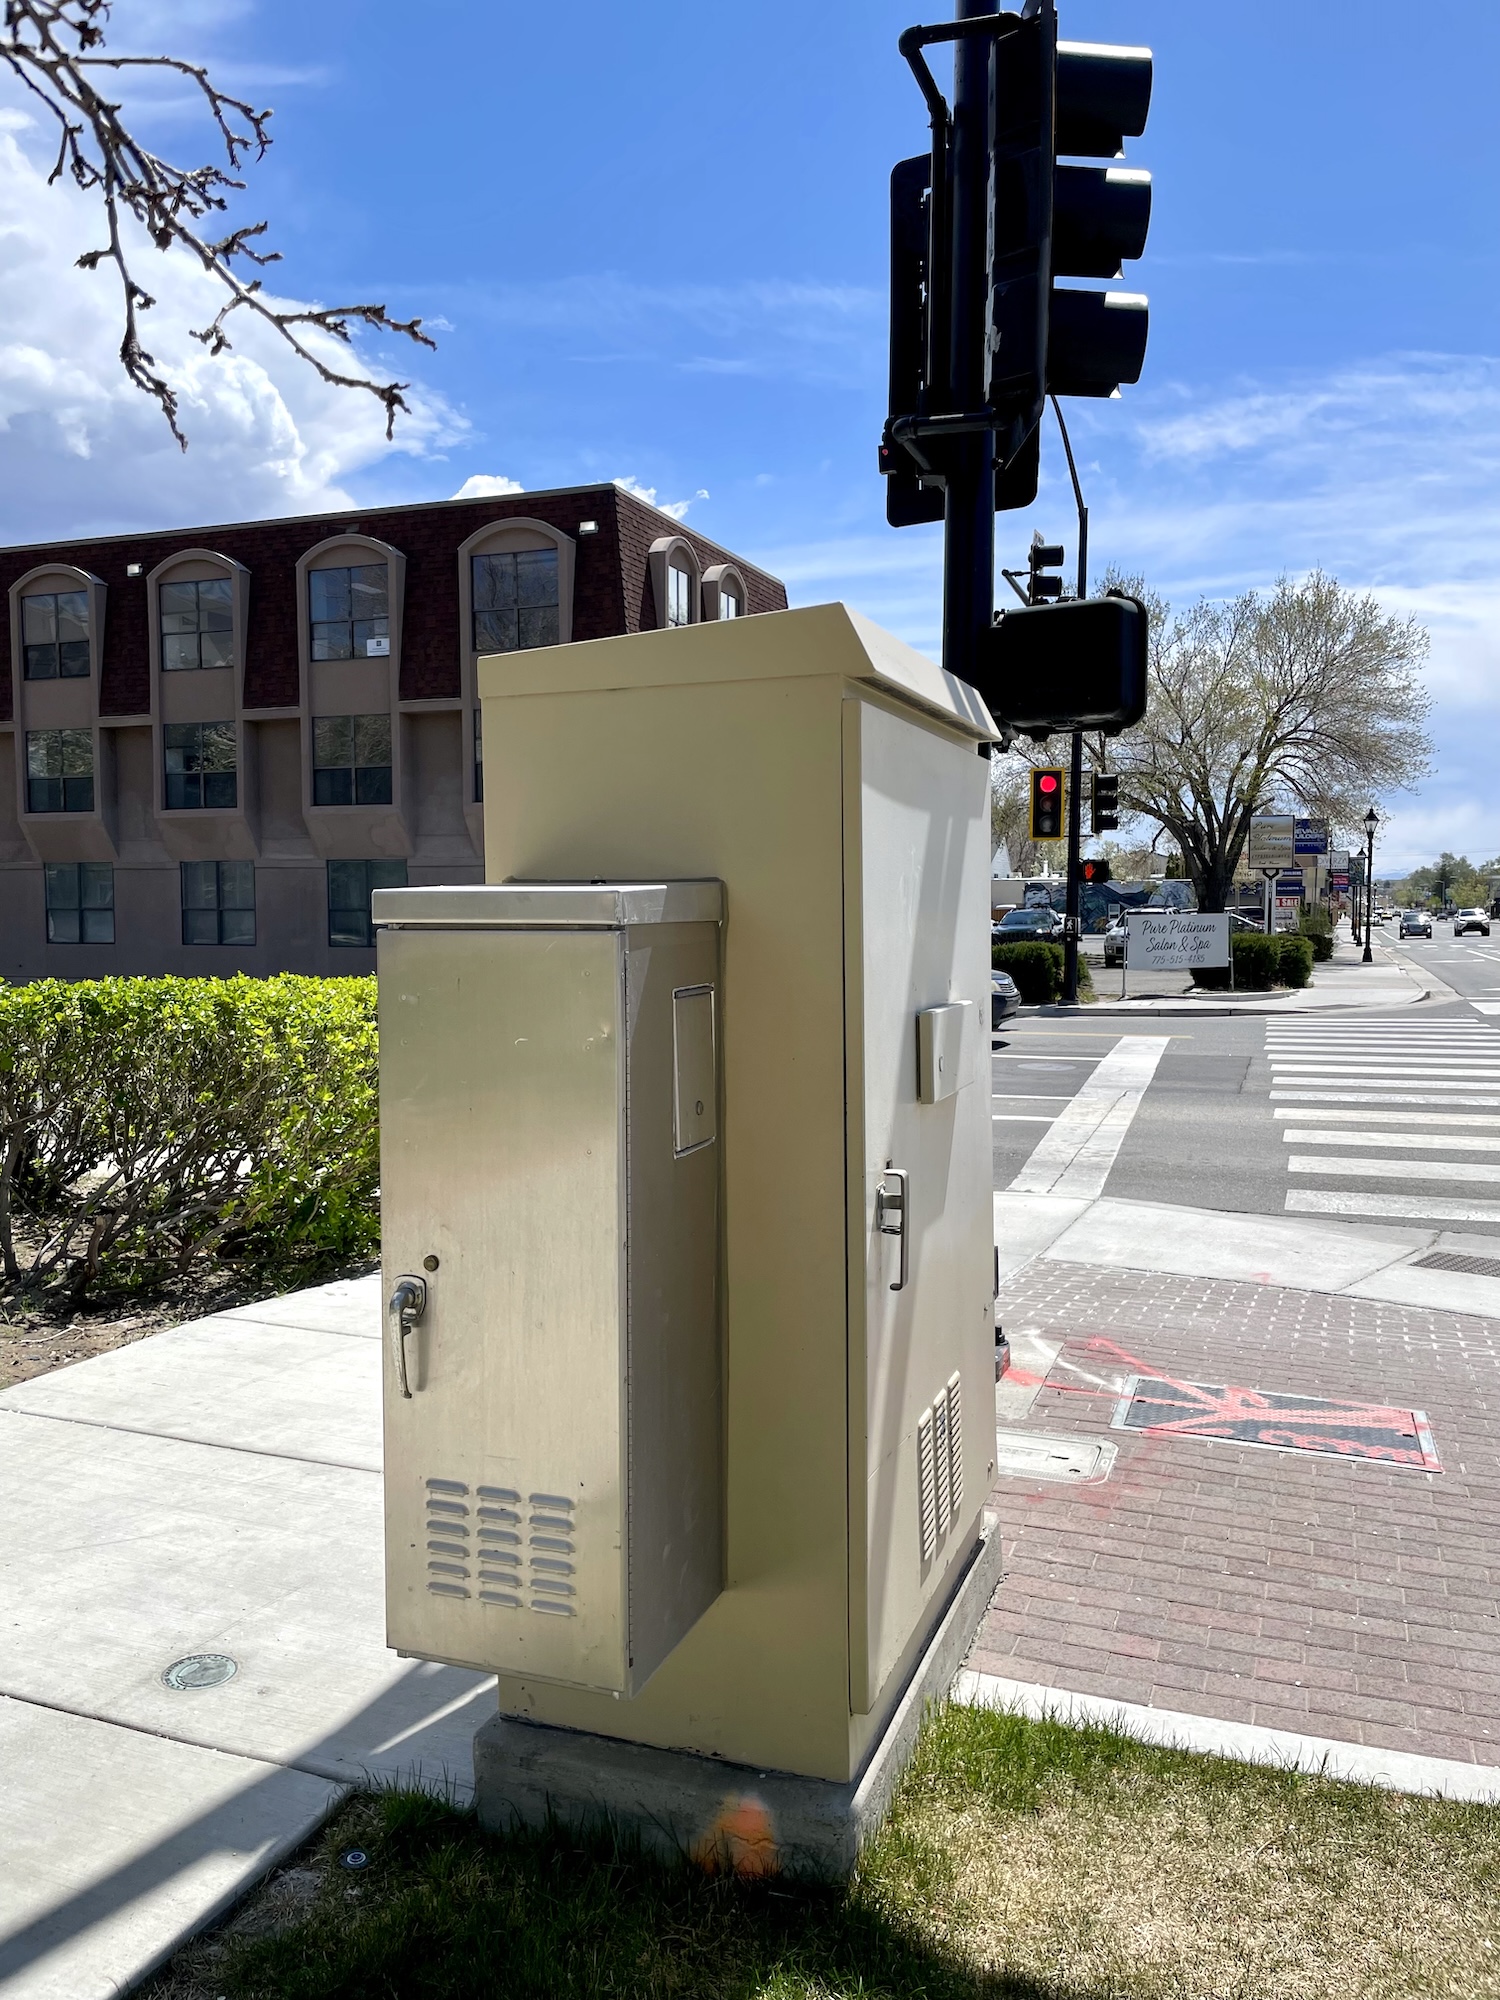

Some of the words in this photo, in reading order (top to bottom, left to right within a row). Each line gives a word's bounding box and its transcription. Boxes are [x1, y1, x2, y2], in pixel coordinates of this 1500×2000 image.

[1281, 898, 1298, 907] SALE
[1142, 919, 1168, 935] Pure
[1169, 919, 1217, 935] Platinum
[1145, 936, 1177, 953] Salon
[1177, 935, 1189, 953] &
[1190, 935, 1212, 954] Spa
[1151, 954, 1206, 965] 775-515-4185
